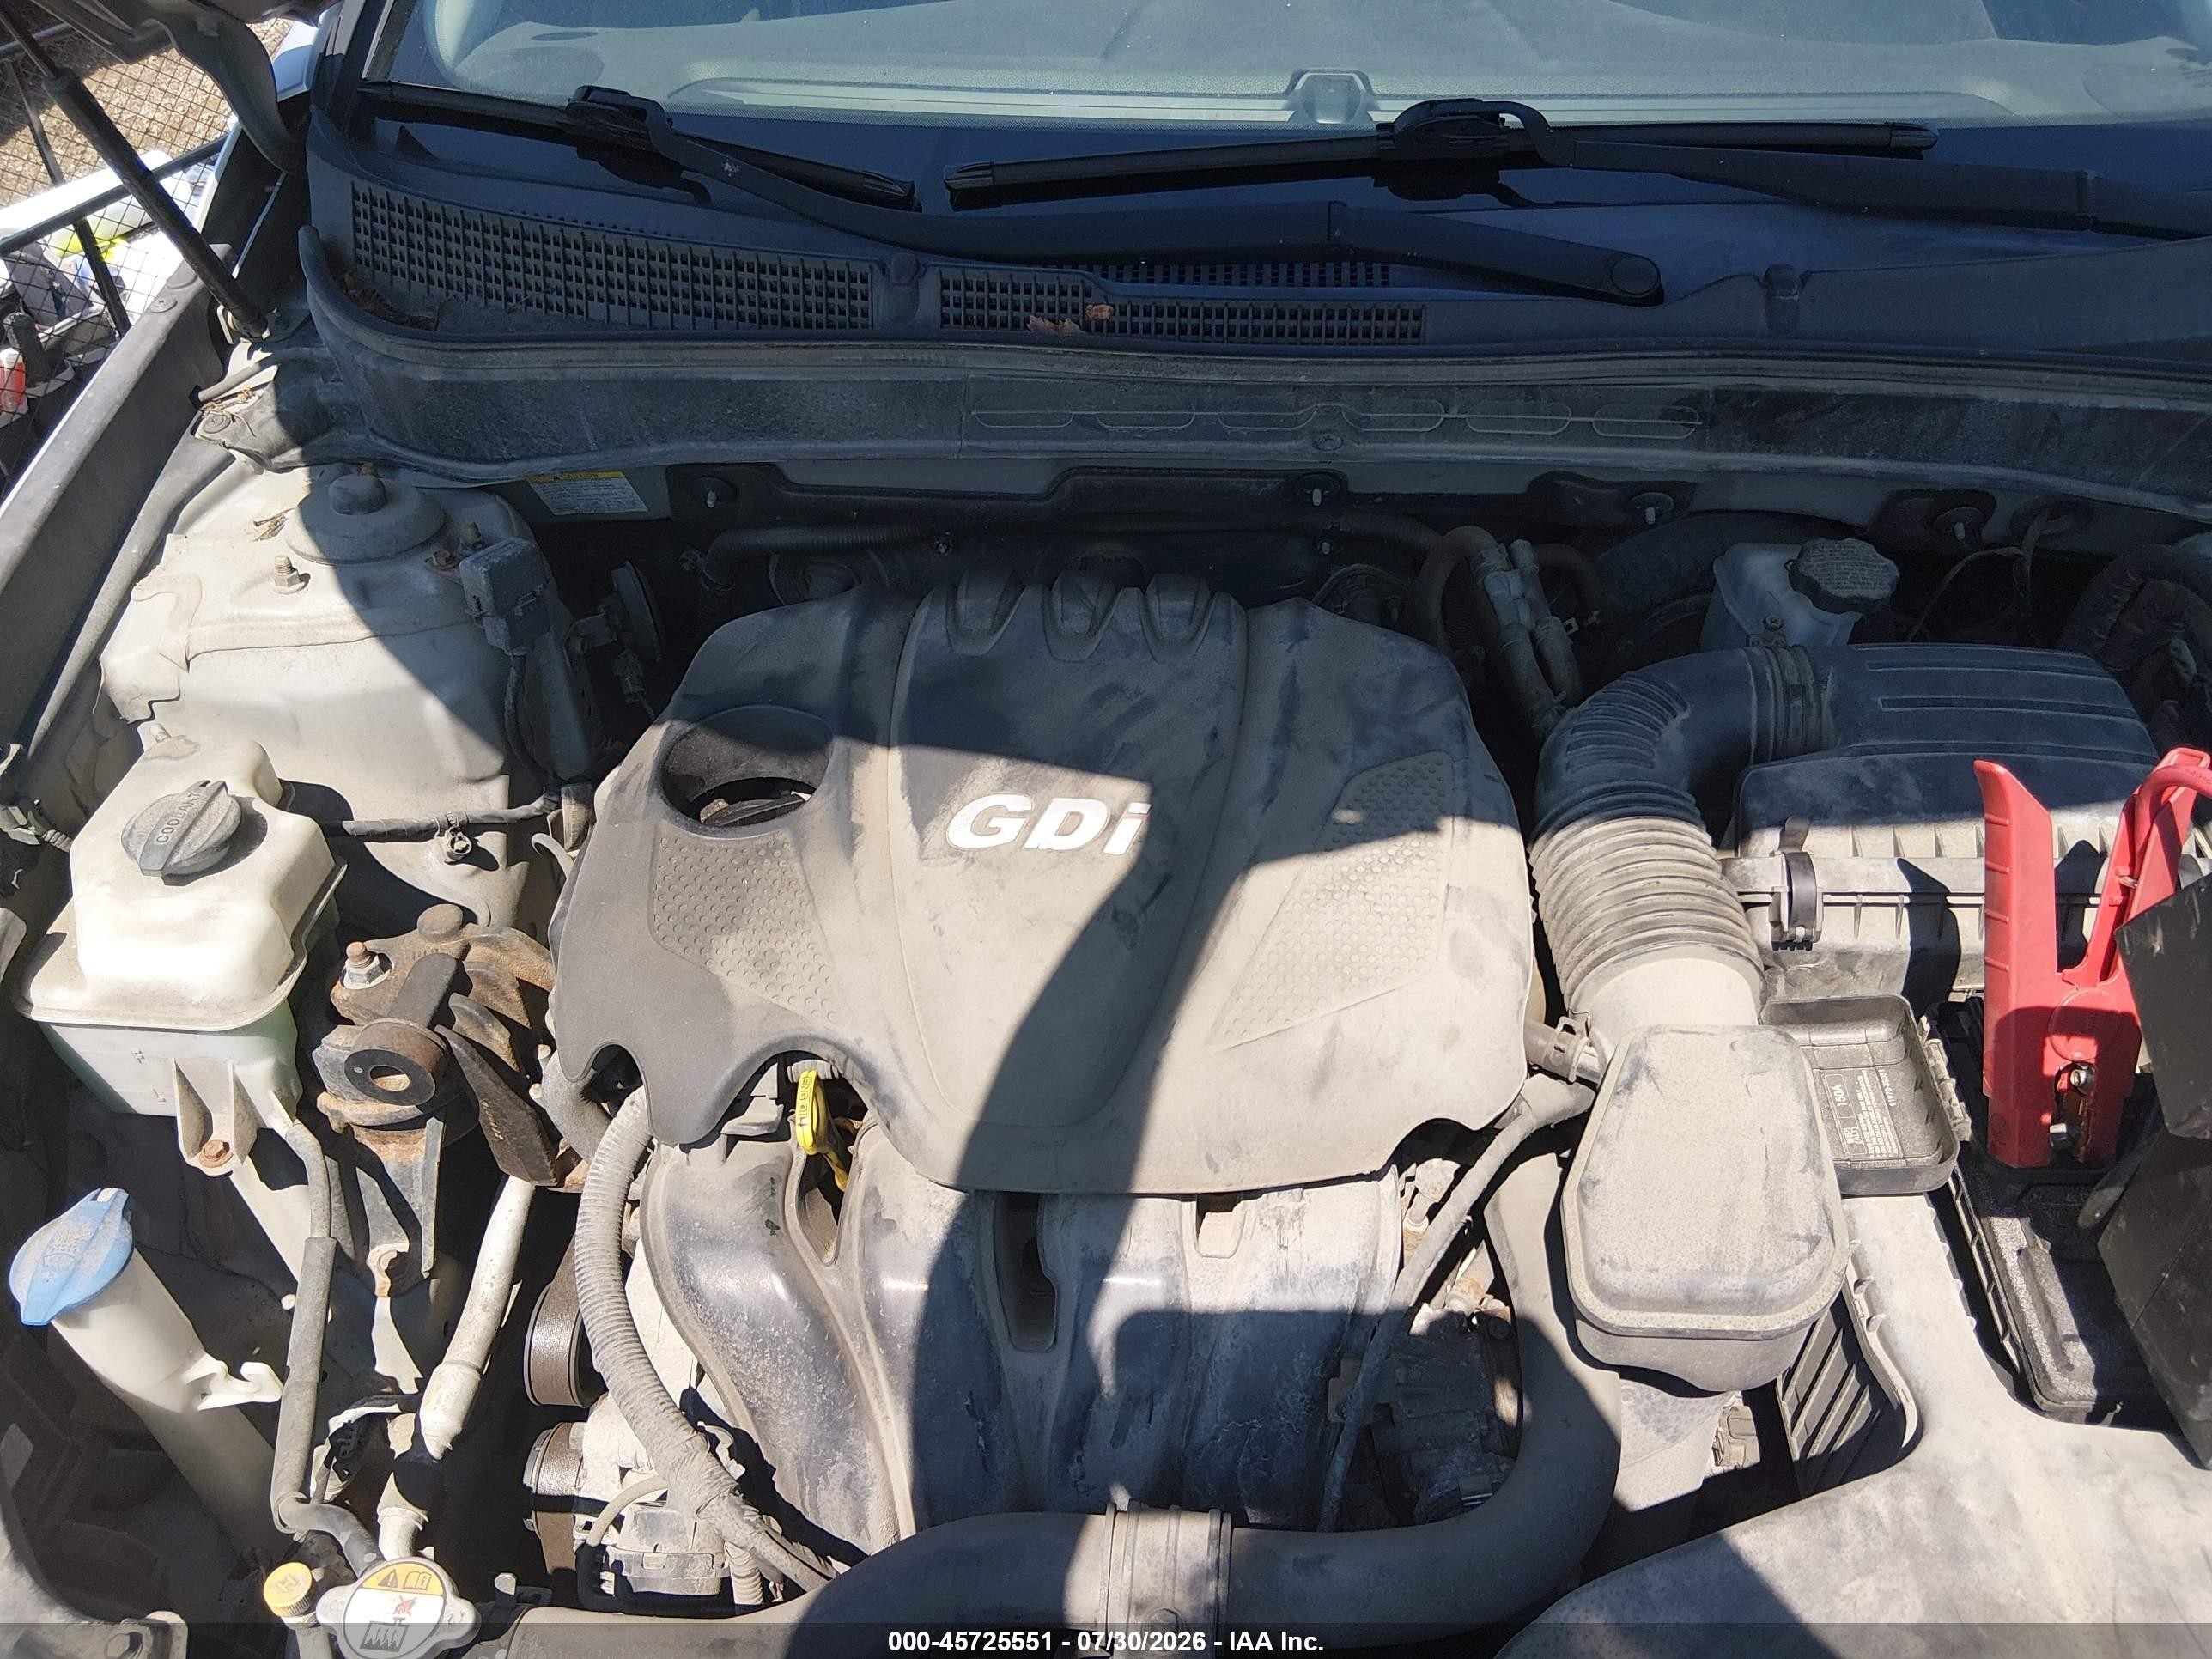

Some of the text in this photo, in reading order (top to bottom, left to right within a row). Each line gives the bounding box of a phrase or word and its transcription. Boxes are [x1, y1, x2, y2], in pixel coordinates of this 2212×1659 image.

[155, 792, 201, 843] COOLANT
[946, 793, 1152, 855] GDi
[798, 1078, 811, 1121] ENG OIL
[1832, 1084, 1848, 1107] 150A
